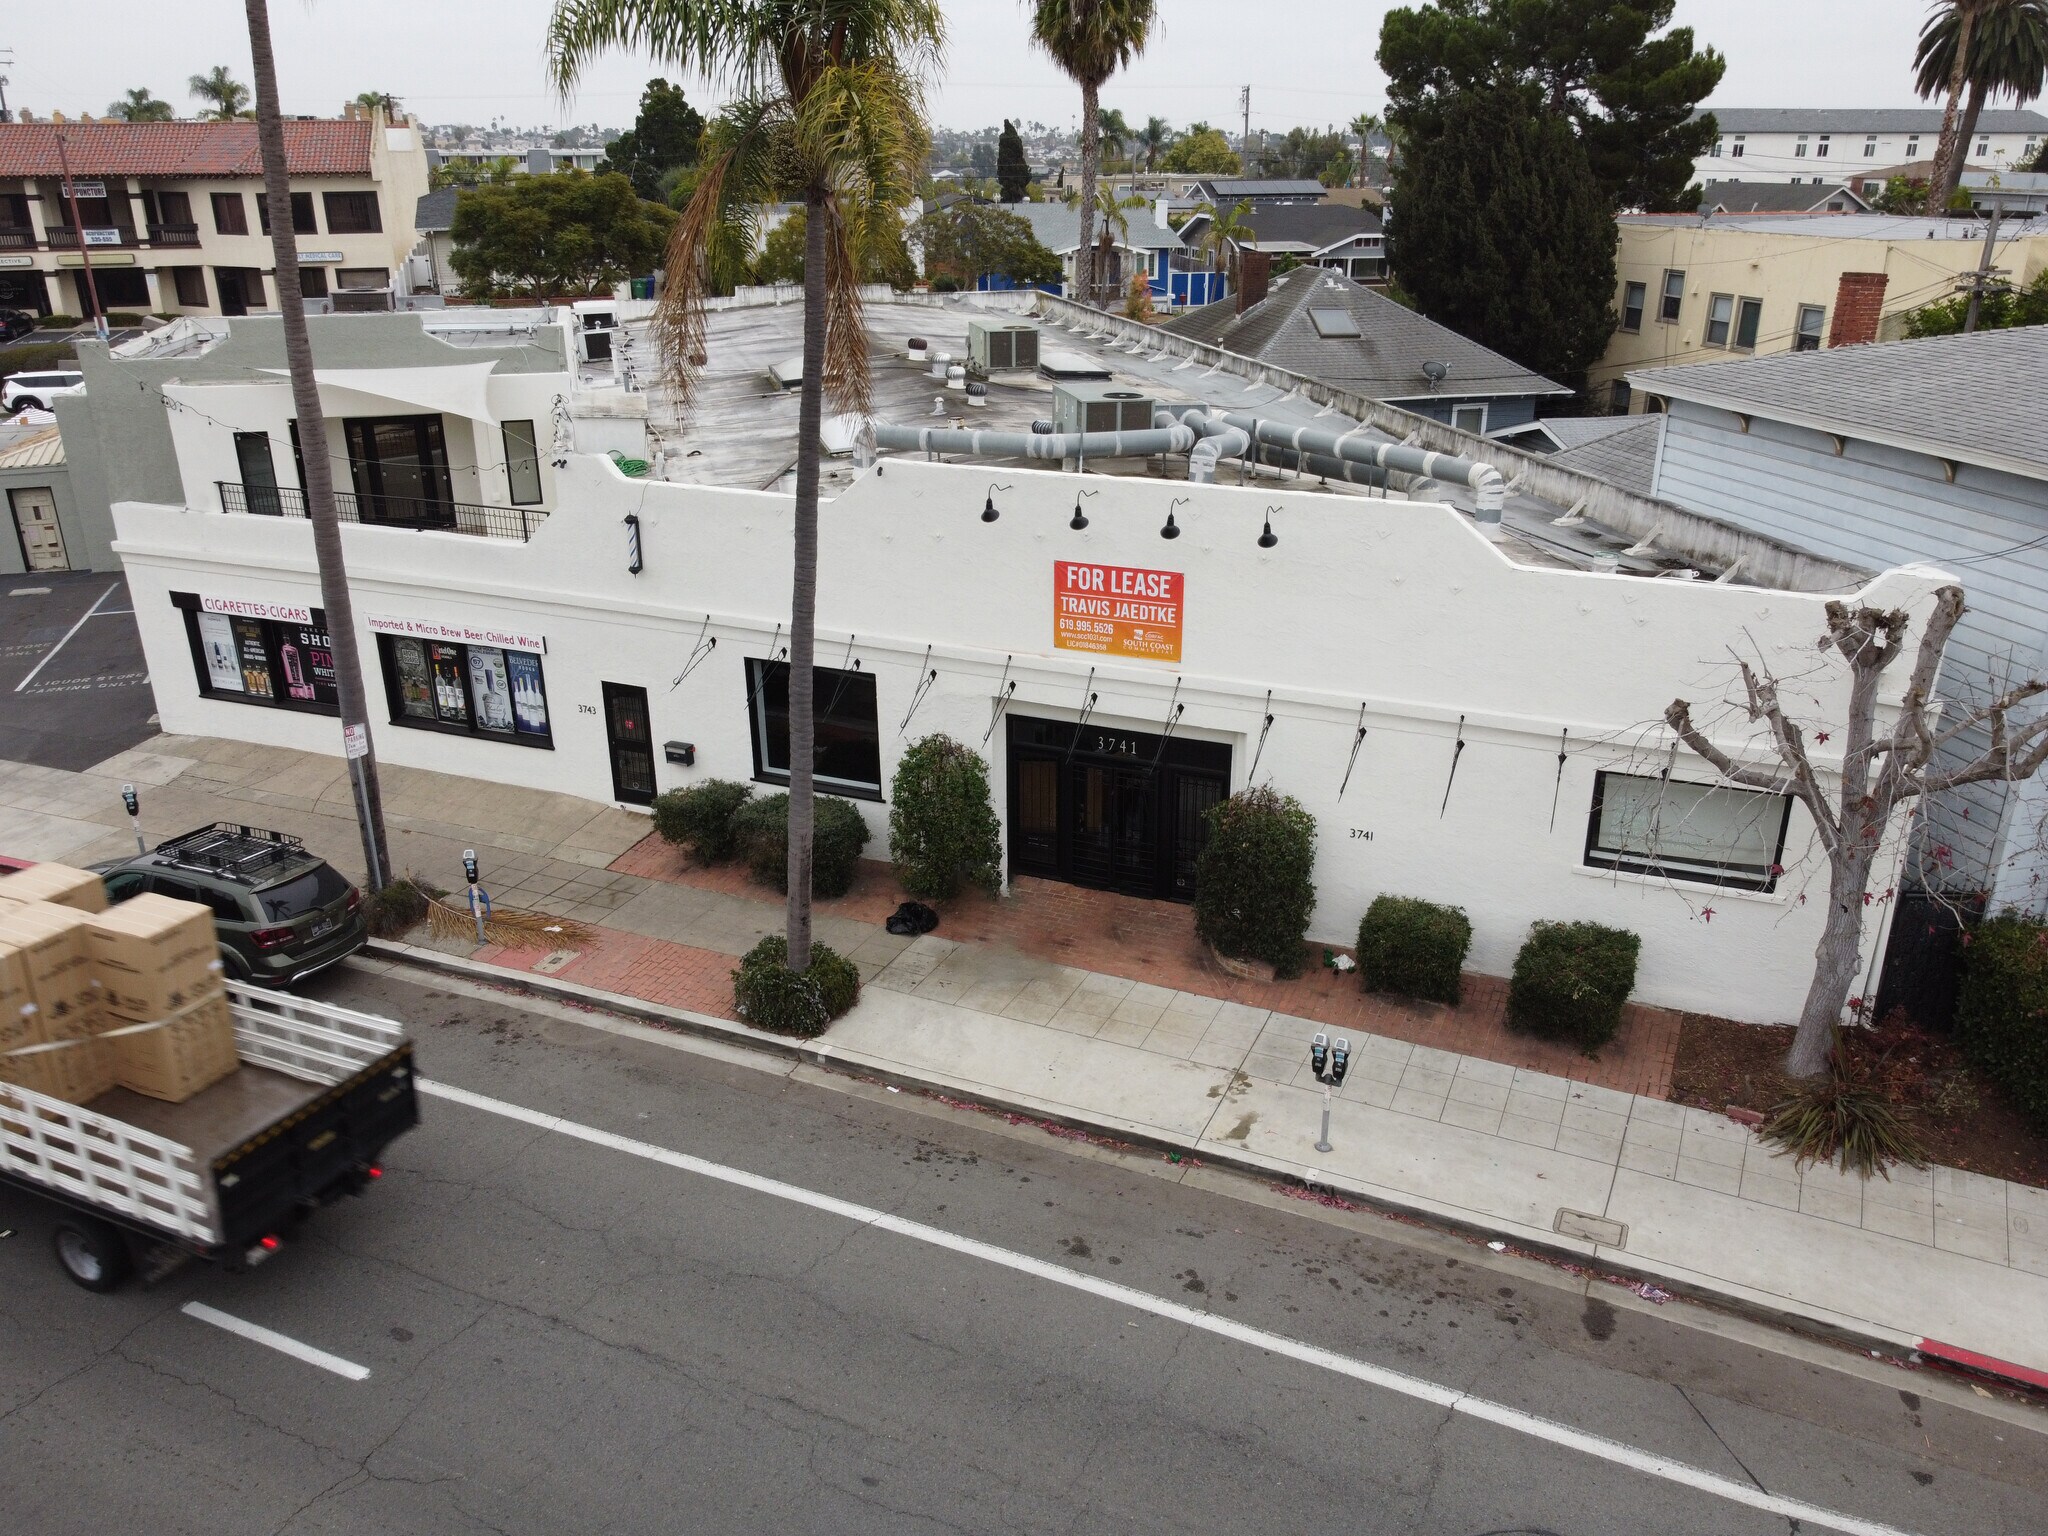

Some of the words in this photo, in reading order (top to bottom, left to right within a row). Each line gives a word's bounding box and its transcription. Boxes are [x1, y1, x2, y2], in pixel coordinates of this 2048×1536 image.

[65, 188, 105, 196] AUPUNCTURE
[1067, 566, 1104, 591] FOR
[1111, 571, 1171, 598] LEASE
[1061, 597, 1110, 616] TRAVIS
[1114, 602, 1176, 623] JAEDTKE
[368, 617, 404, 630] Imported
[406, 622, 413, 631] &
[415, 623, 438, 634] Micro
[440, 626, 461, 637] Brew
[464, 629, 483, 640] Beer
[486, 632, 514, 644] Chilled
[517, 636, 540, 648] Wine
[1060, 618, 1114, 634] 619.995.5526
[300, 632, 331, 647] SHO
[1123, 638, 1148, 648] SOUTH
[1150, 642, 1174, 651] COAST
[311, 651, 334, 668] PIN
[313, 667, 335, 678] WHIT
[34, 677, 91, 686] LIQUOR
[96, 673, 144, 682] STORE
[25, 684, 92, 694] PARKING
[578, 704, 597, 715] 3743
[345, 727, 355, 736] NO
[1098, 736, 1137, 755] 3741
[1349, 828, 1374, 841] 3741
